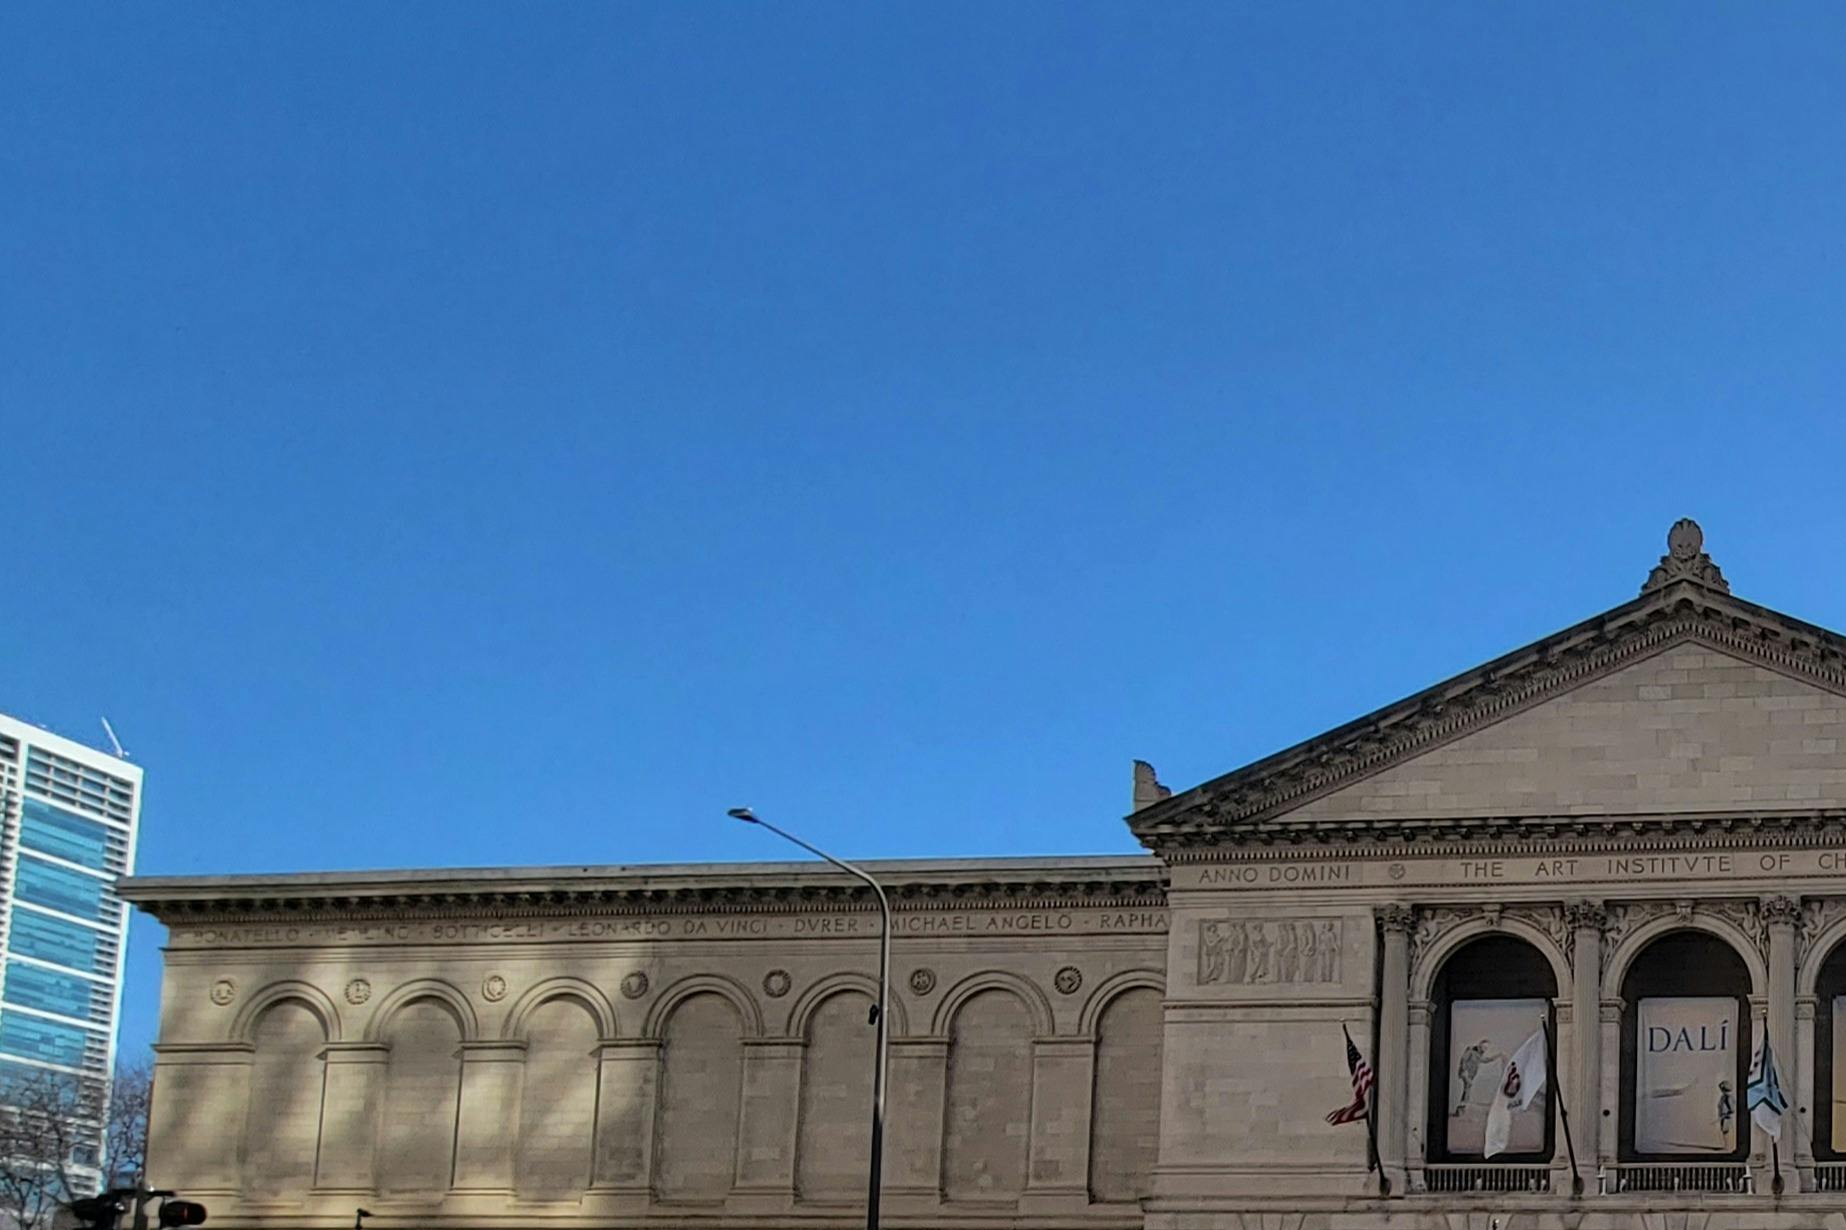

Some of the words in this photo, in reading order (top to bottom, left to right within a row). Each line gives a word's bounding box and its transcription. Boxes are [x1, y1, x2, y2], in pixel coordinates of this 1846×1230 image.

[1199, 867, 1259, 884] ANNO
[1268, 865, 1350, 882] DOMINI
[1460, 861, 1504, 878] THE
[1535, 860, 1579, 876] ART
[1607, 855, 1732, 875] INSTITVTE
[1759, 854, 1791, 871] OF
[568, 921, 671, 937] LEONARDO
[683, 920, 707, 935] DA
[716, 919, 768, 934] VINCI
[793, 918, 859, 933] DVRER
[985, 914, 1073, 931] ANGELO
[1100, 913, 1169, 929] RAPHA
[1649, 1019, 1728, 1052] DALÍ
